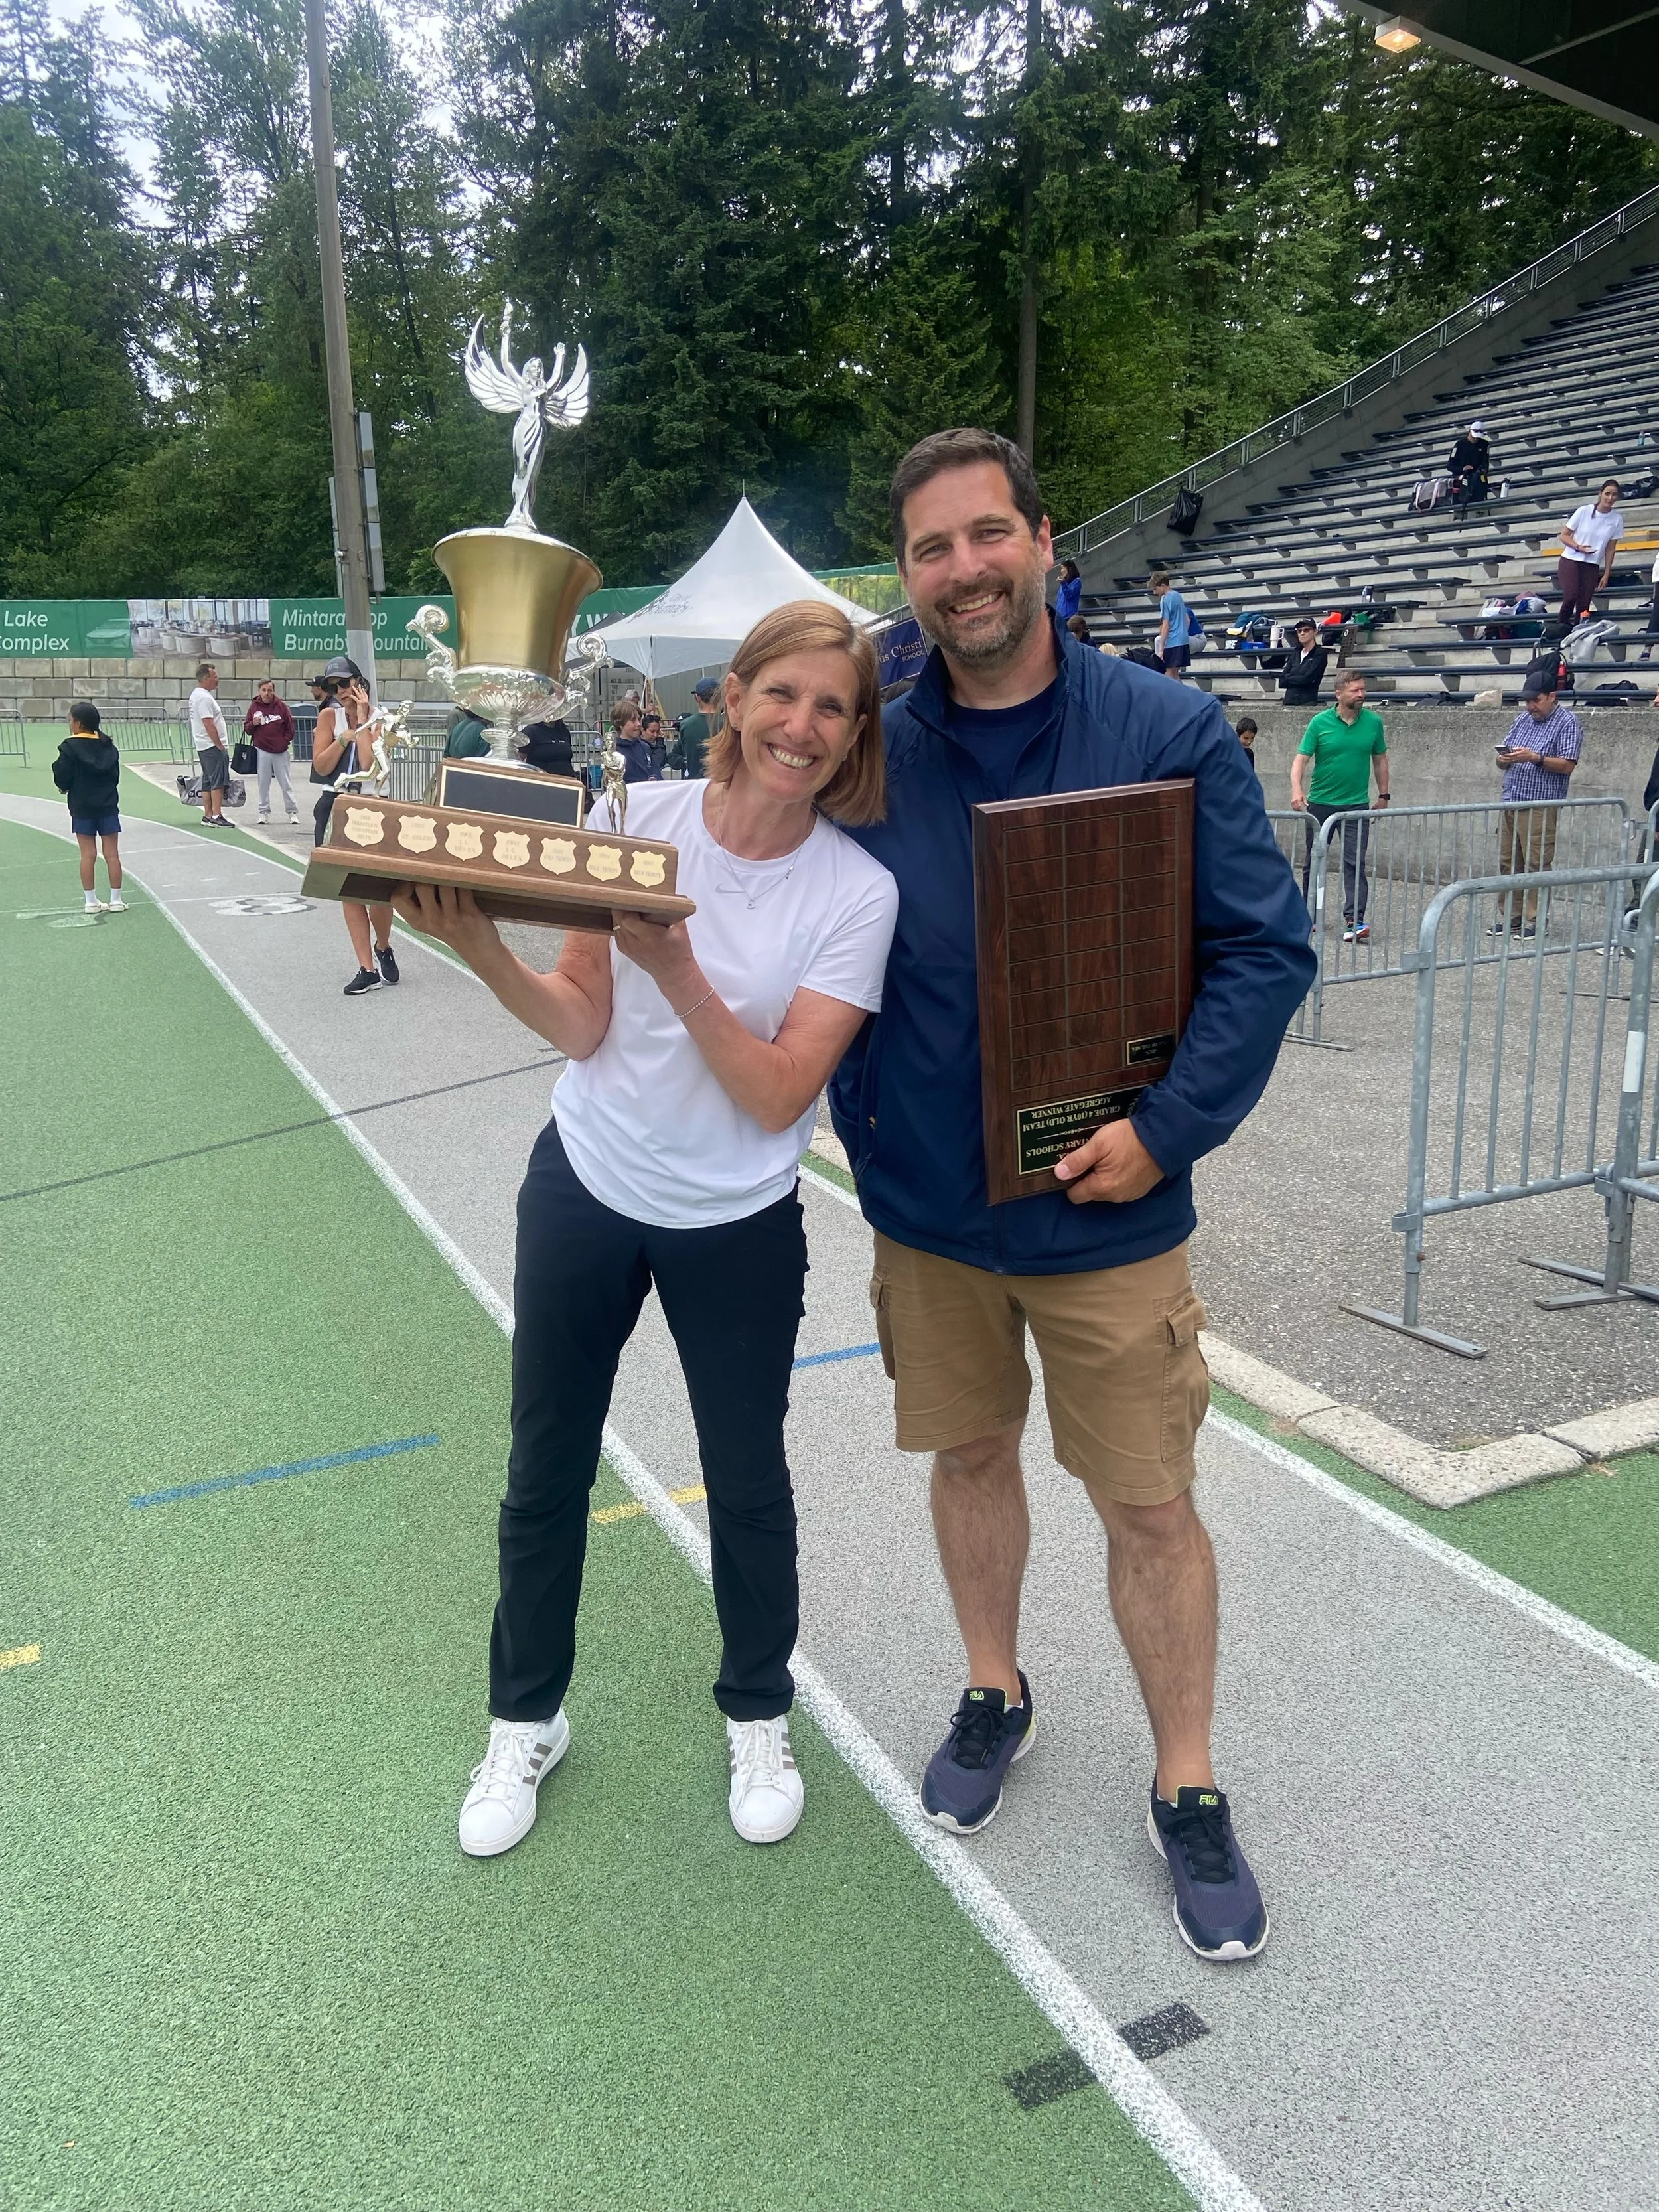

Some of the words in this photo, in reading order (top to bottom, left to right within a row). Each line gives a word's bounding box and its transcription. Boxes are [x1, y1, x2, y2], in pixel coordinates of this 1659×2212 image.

[4, 610, 48, 627] Lake
[282, 609, 346, 627] Mintara
[374, 634, 428, 650] ountai
[891, 638, 922, 658] Christi
[902, 650, 924, 662] SCHOOL
[502, 853, 522, 862] DELTA
[1064, 1096, 1112, 1110] AGGREGATE
[1031, 1106, 1064, 1119] WINNER
[1094, 1105, 1121, 1117] GRADE
[1023, 1120, 1046, 1132] TEAM
[1046, 1116, 1066, 1127] OLD)
[1025, 1143, 1064, 1157] SCHOOLS
[969, 1690, 985, 1700] FILA
[1199, 1794, 1219, 1805] FILA
